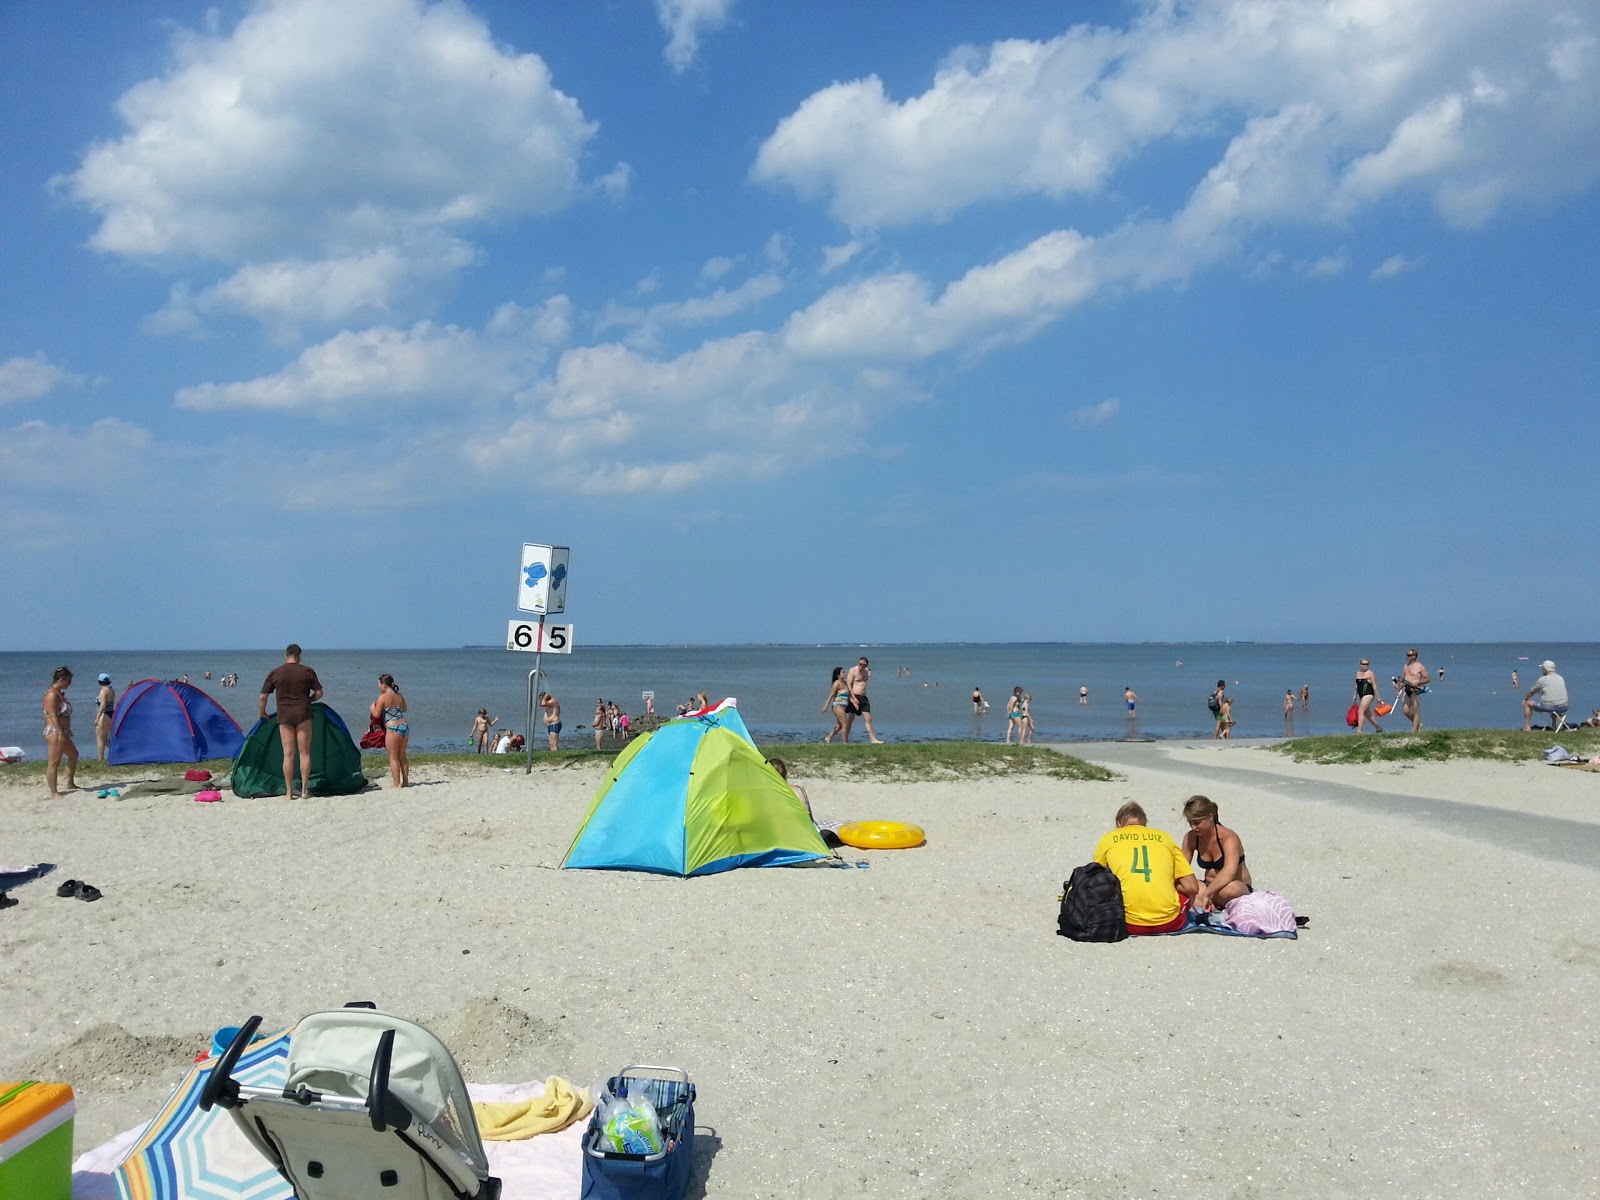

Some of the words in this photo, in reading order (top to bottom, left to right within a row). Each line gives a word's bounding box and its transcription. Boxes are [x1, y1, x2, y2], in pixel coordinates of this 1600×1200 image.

[514, 624, 532, 647] 6
[549, 626, 566, 649] 5
[1112, 833, 1139, 843] DAVID
[1142, 833, 1162, 843] LUIZ
[1130, 845, 1152, 883] 4
[417, 1122, 443, 1150] Quinny
